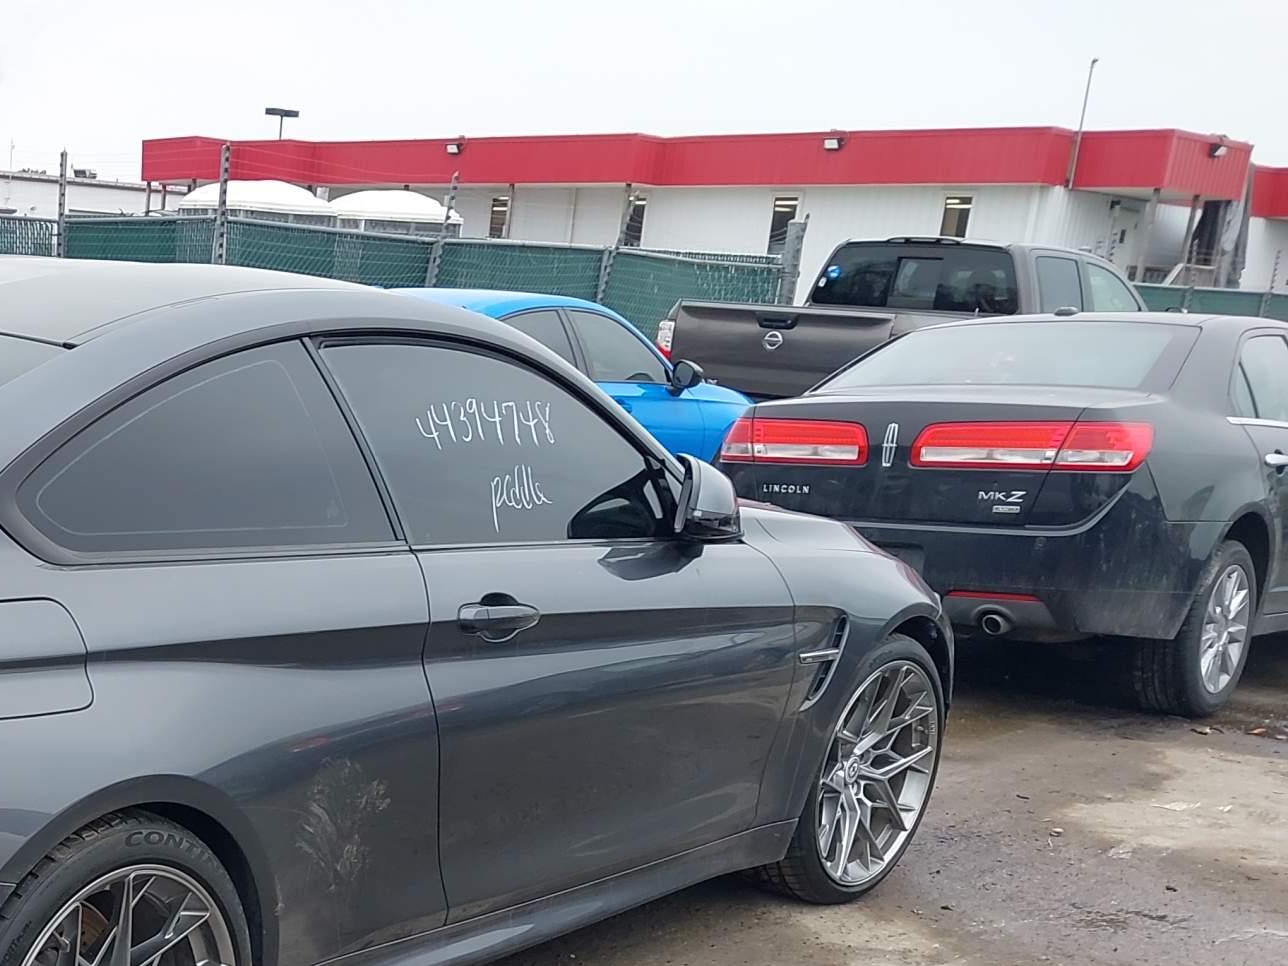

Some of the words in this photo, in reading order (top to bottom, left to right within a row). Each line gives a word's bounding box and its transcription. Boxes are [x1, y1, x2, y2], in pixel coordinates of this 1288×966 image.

[416, 398, 555, 450] 44394748
[763, 484, 810, 494] LINCOLN
[978, 491, 1027, 502] MKZ
